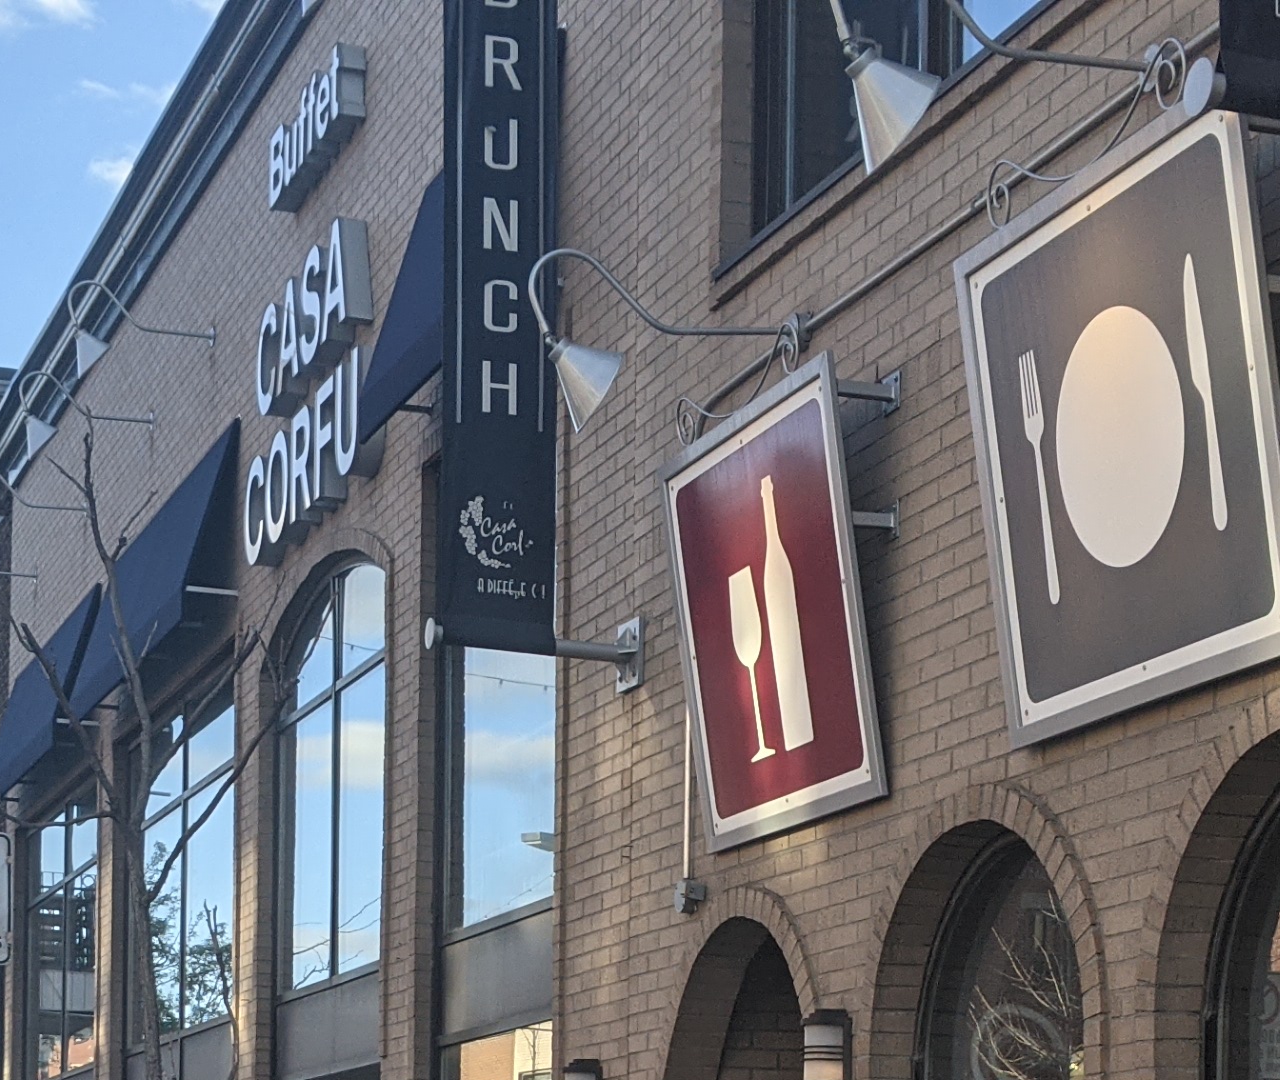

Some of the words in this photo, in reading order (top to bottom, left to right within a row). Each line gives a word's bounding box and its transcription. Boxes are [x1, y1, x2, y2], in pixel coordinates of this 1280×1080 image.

[268, 44, 342, 211] Buffet
[257, 217, 347, 418] CASA
[243, 346, 360, 567] CORFU
[480, 517, 517, 538] Casa
